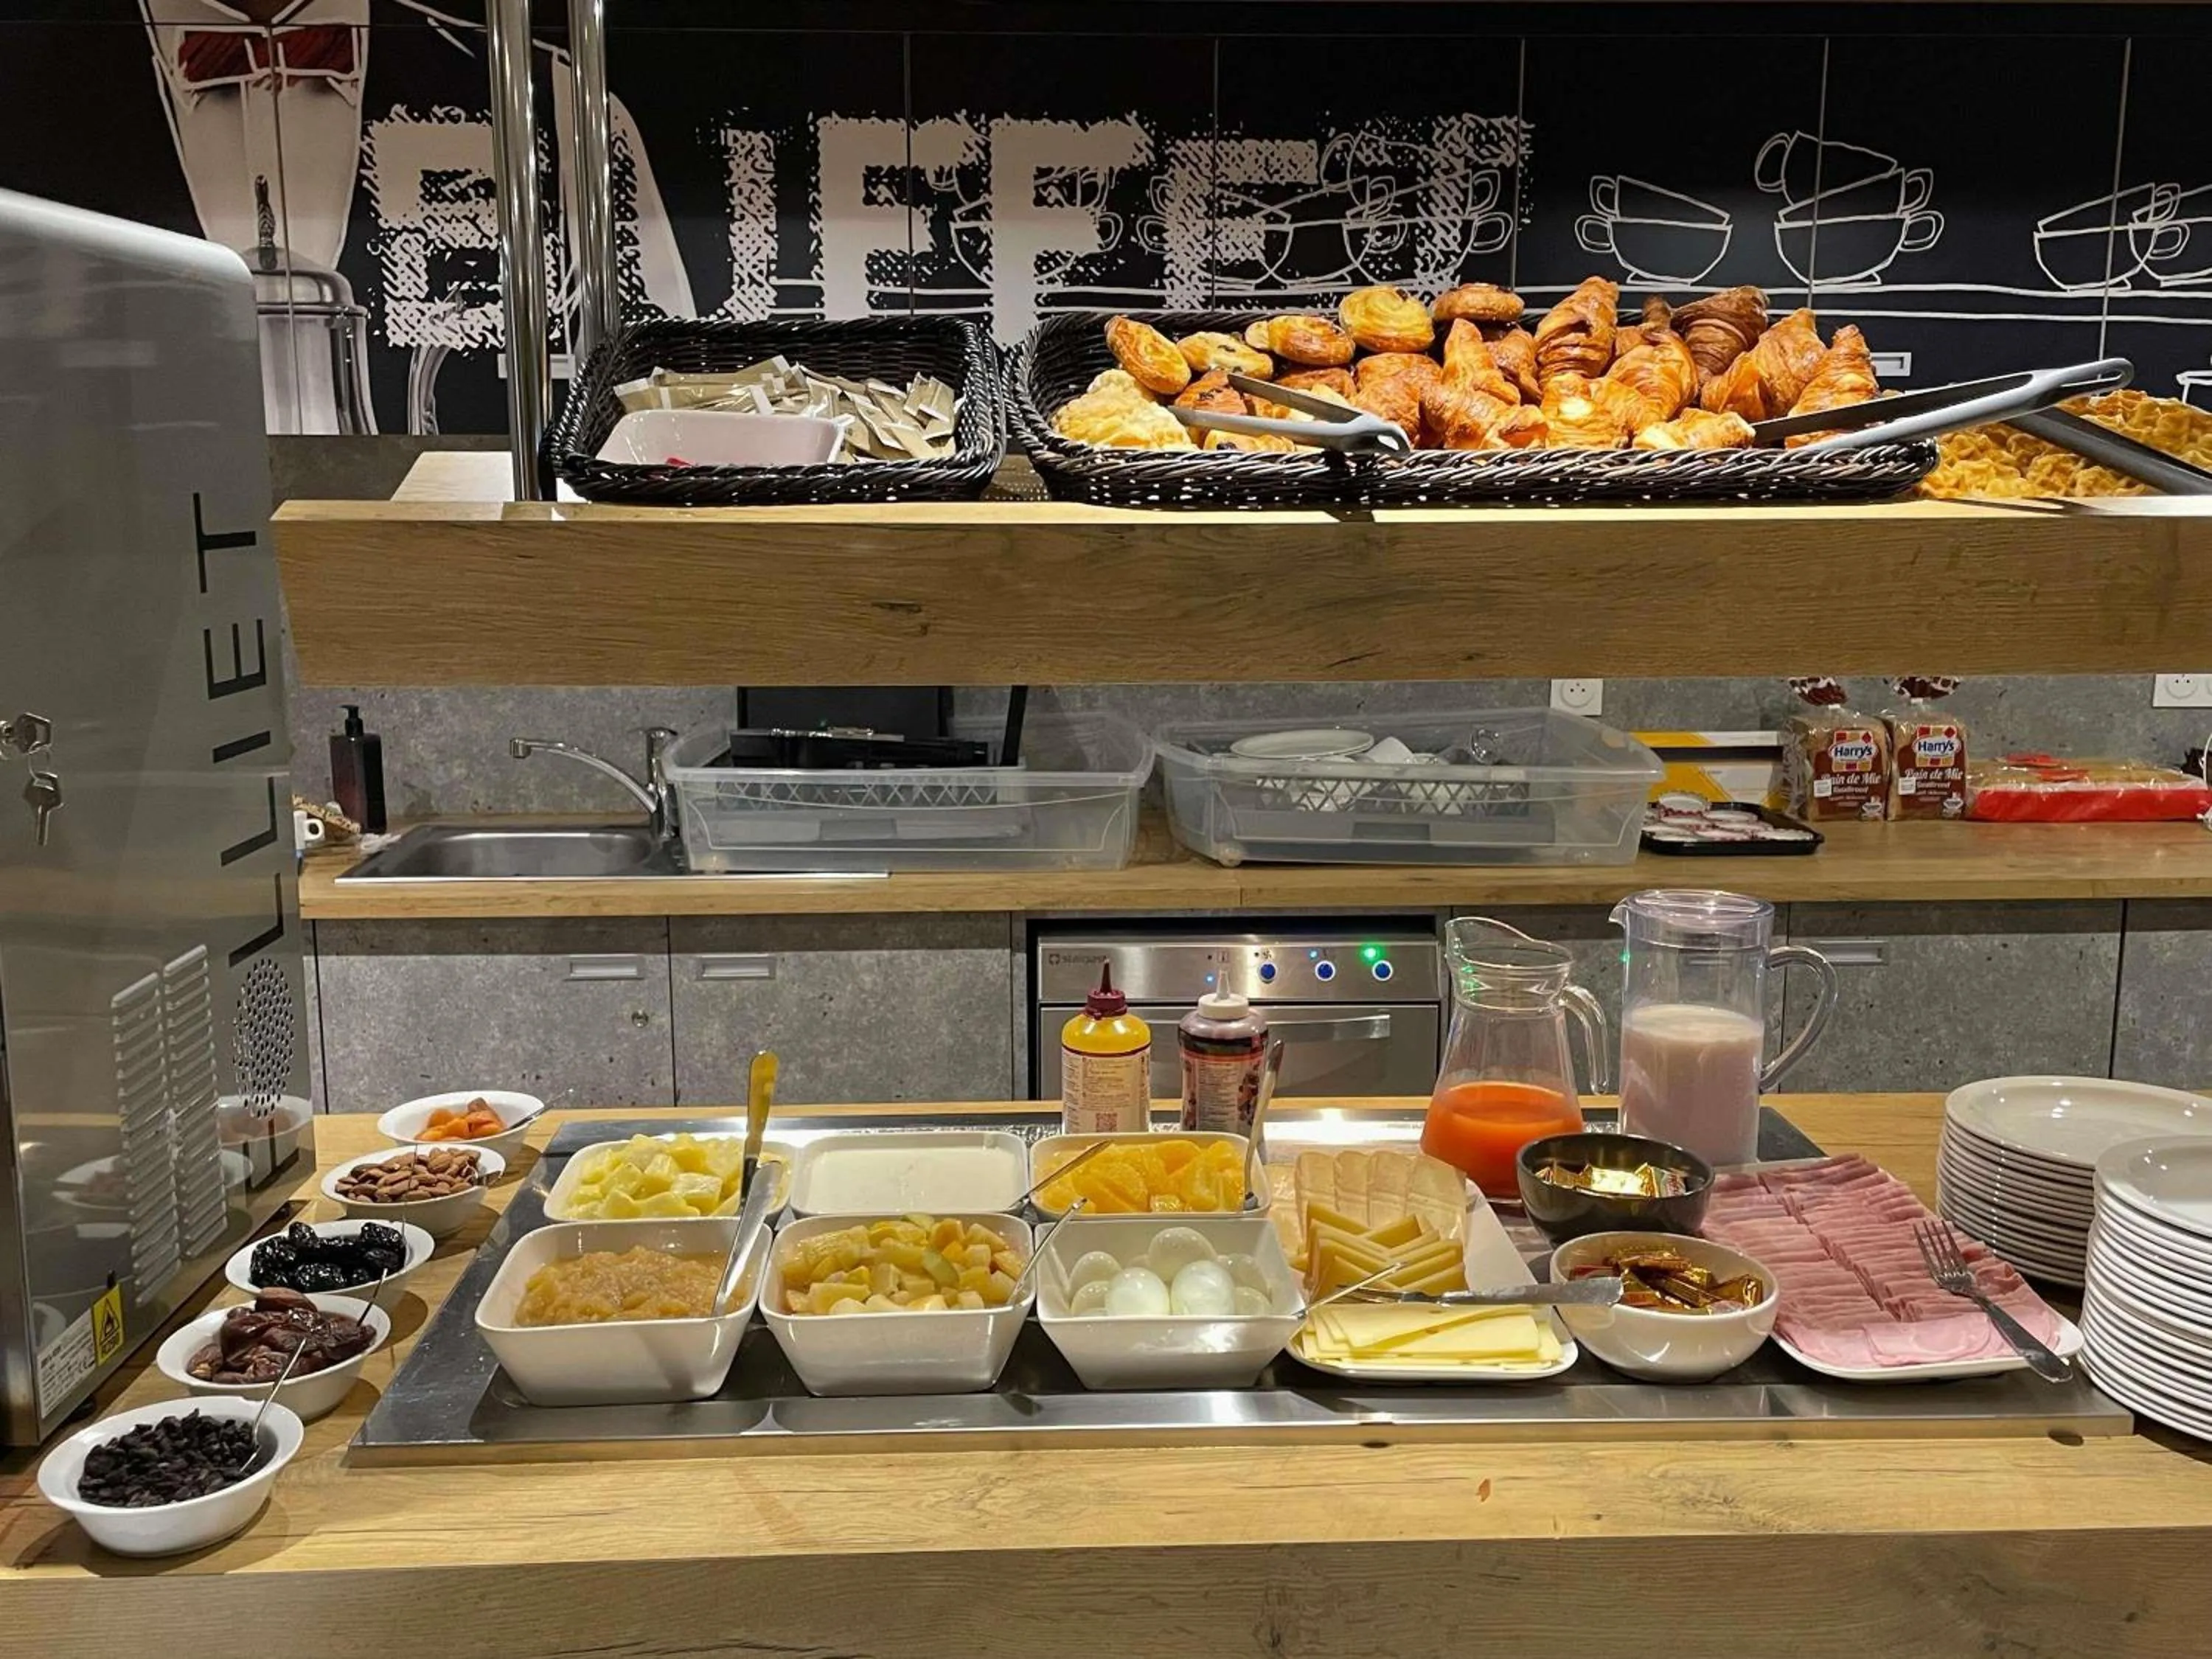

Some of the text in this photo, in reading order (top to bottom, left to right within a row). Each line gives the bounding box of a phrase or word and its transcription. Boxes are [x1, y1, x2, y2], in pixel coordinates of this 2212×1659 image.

[1834, 745, 1872, 758] Harry's
[1918, 740, 1955, 753] Harry's
[1846, 772, 1861, 785] de
[1930, 768, 1943, 779] de
